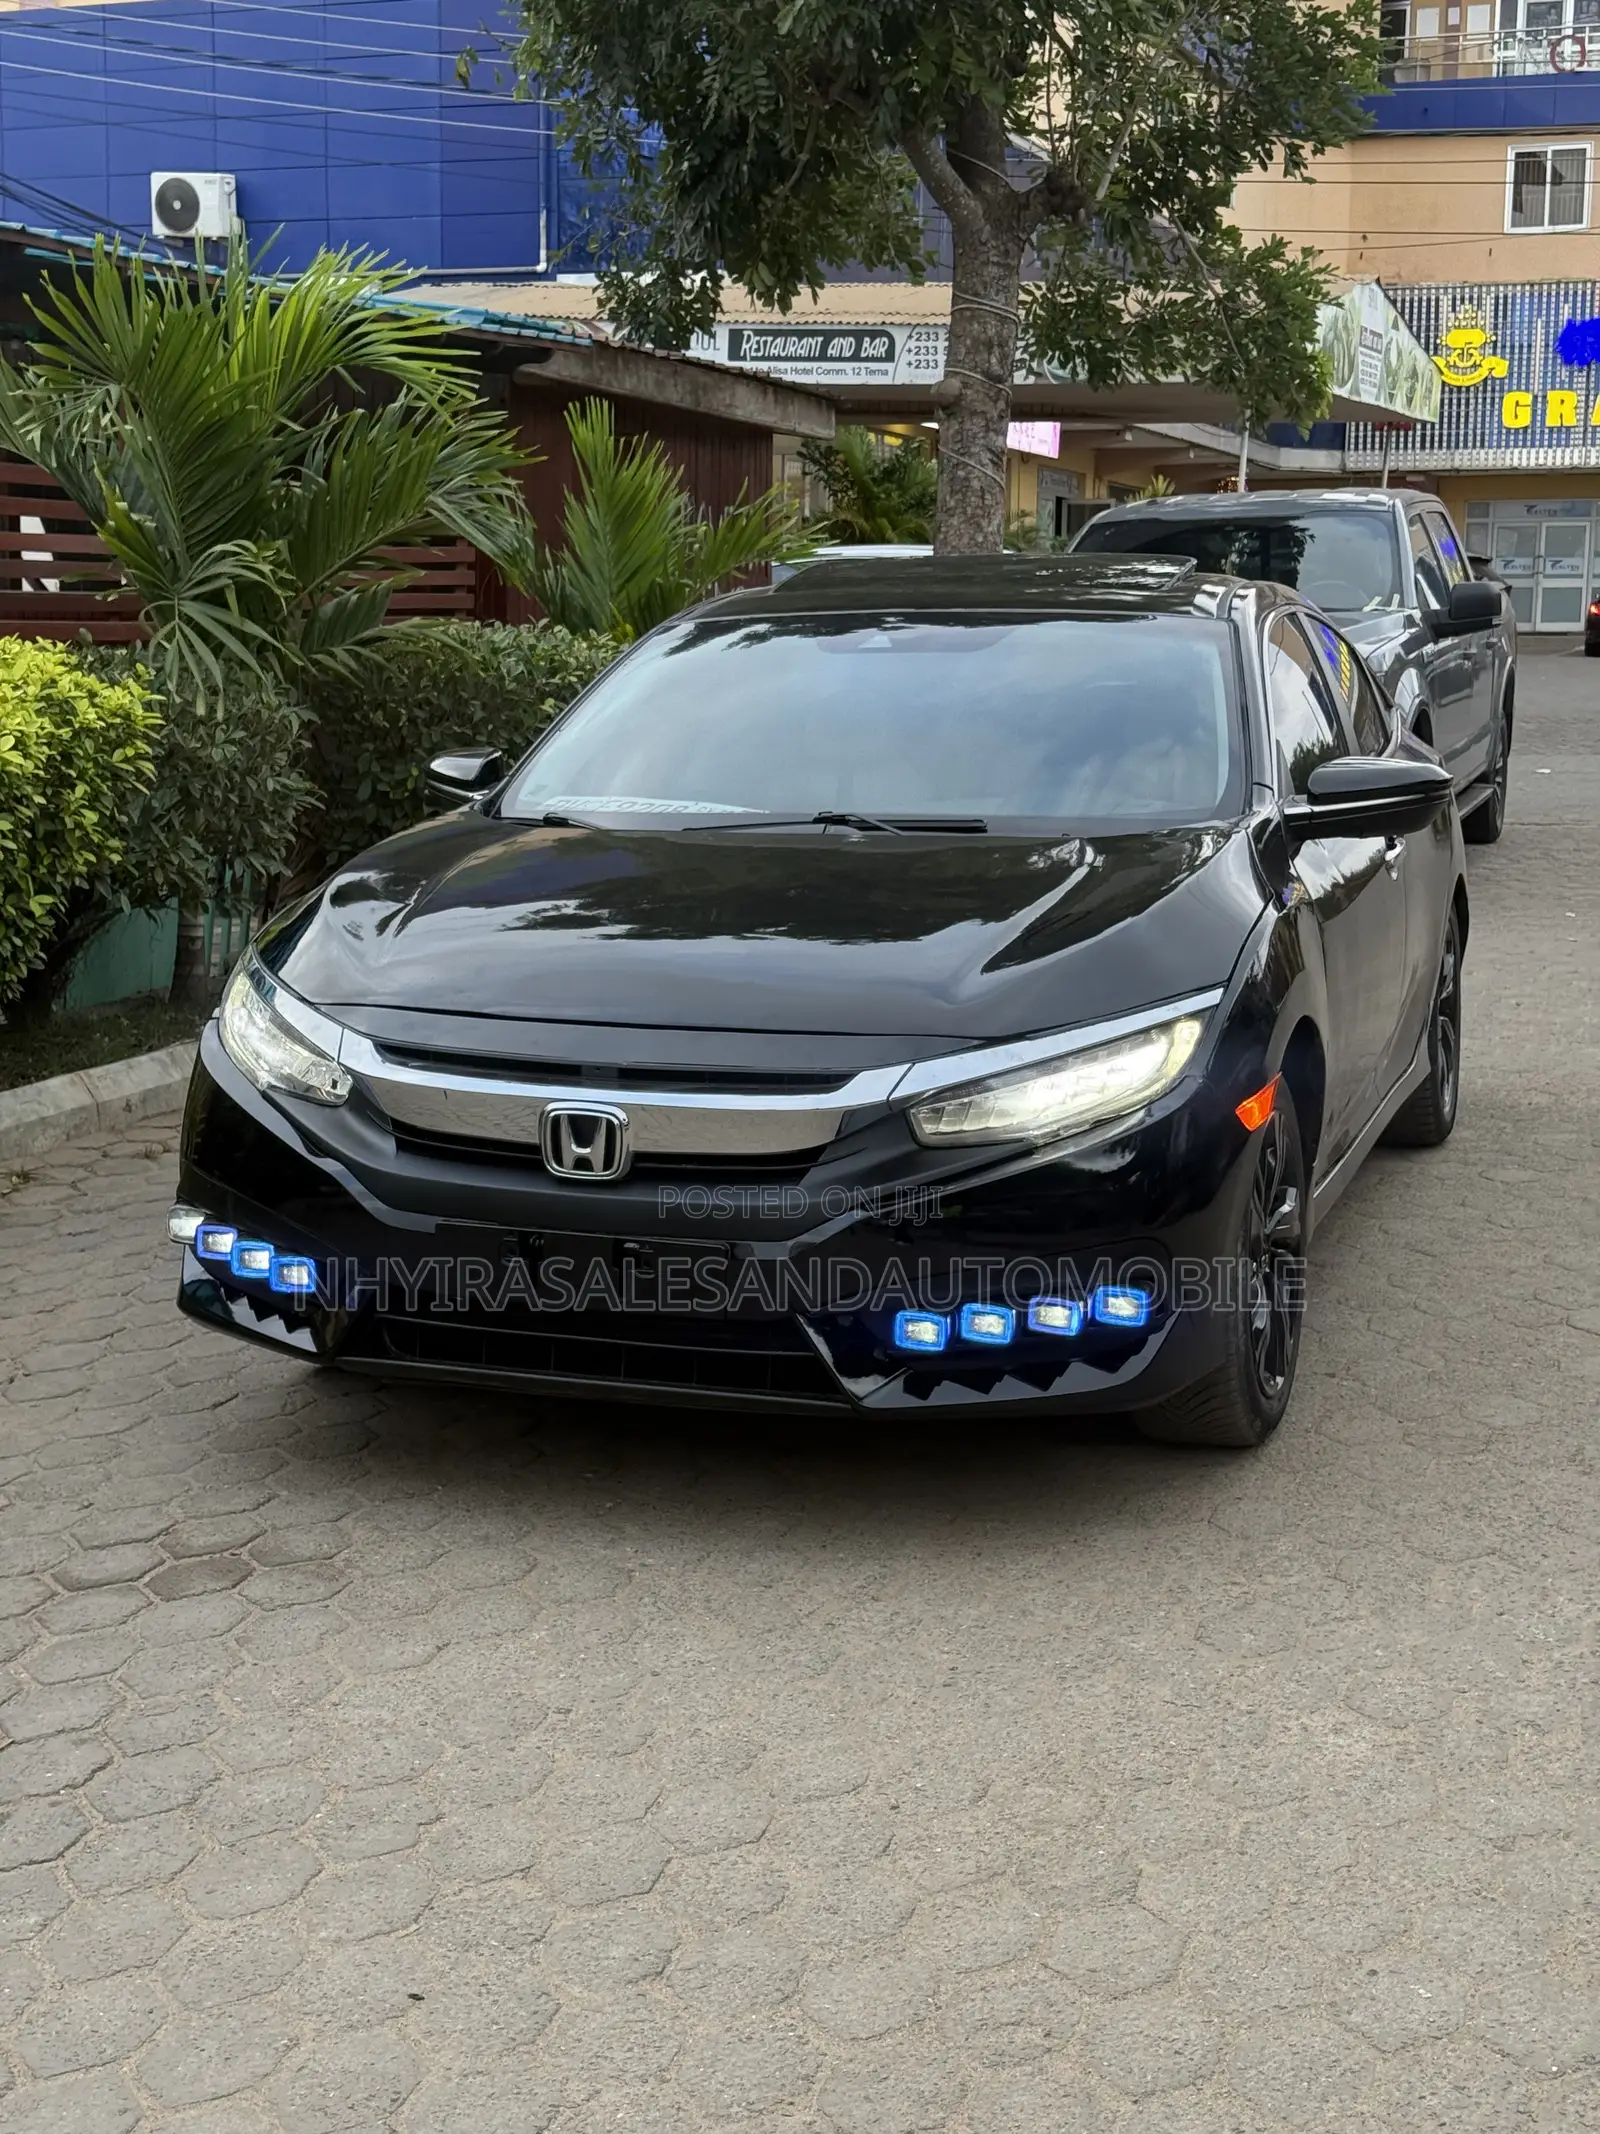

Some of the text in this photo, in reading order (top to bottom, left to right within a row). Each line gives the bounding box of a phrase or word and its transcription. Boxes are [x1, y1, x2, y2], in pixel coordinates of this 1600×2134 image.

[907, 331, 939, 342] +233
[740, 330, 889, 362] RESTAURANT AND BAR
[906, 345, 938, 357] +233
[906, 359, 939, 370] +233
[790, 366, 814, 376] Hotel
[815, 366, 849, 376] Comm.
[851, 366, 862, 376] 12
[864, 366, 889, 377] Tema
